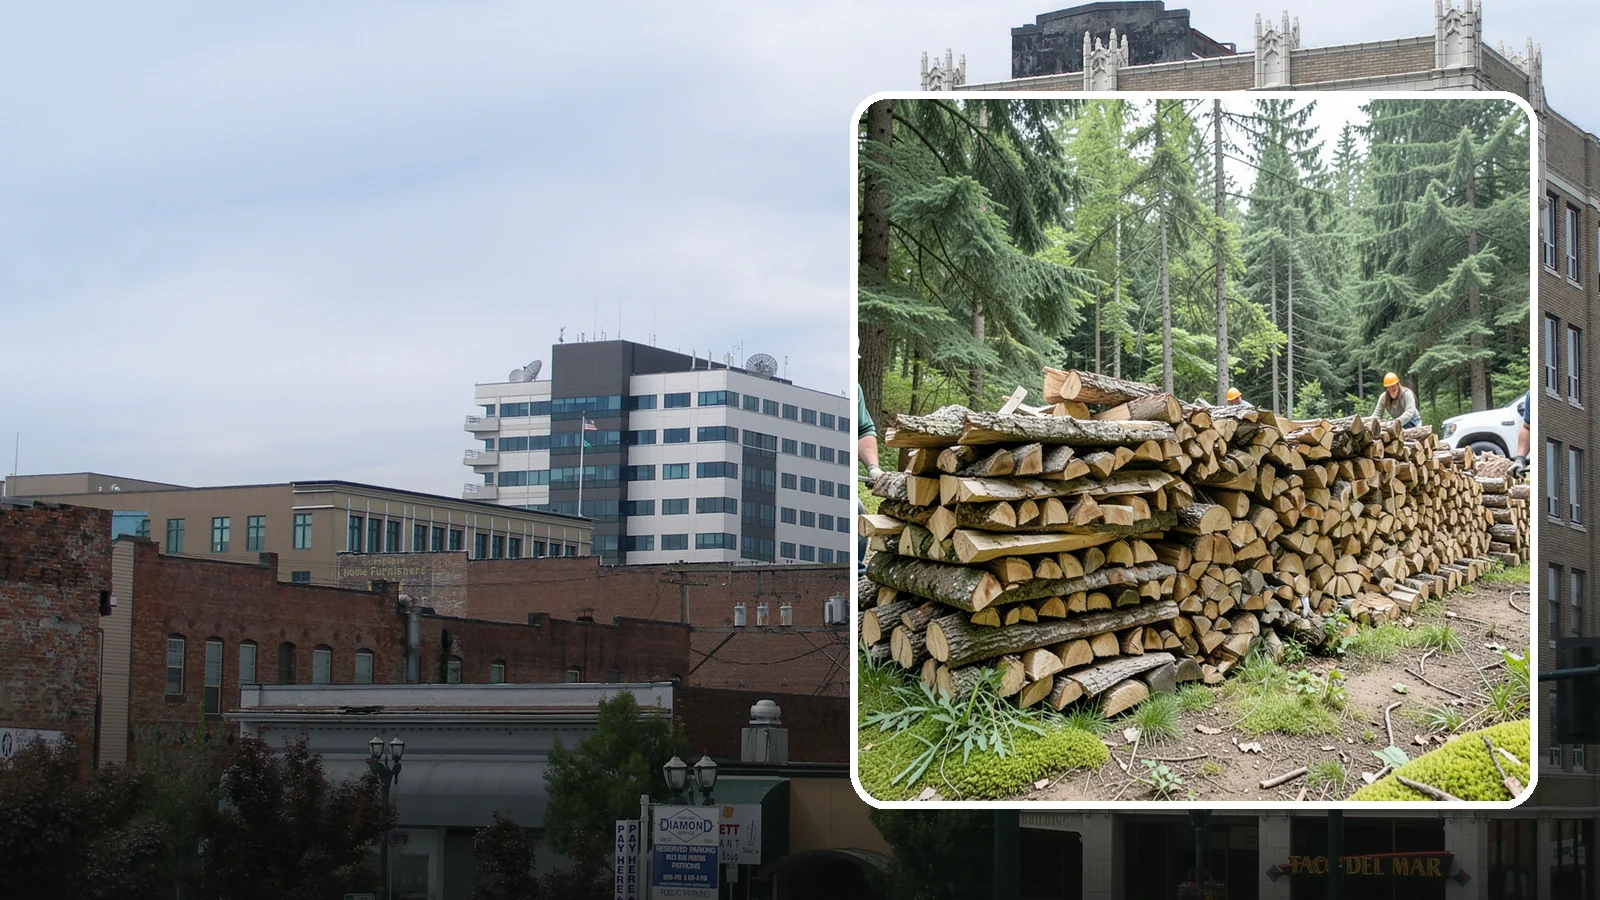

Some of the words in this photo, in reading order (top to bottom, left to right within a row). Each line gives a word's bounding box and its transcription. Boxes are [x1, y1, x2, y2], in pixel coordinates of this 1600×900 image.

[343, 567, 367, 577] Home
[370, 566, 427, 576] Furnishers
[1022, 815, 1070, 828] BUILDING
[617, 825, 625, 852] PAY
[628, 824, 637, 852] PAY
[656, 845, 688, 853] RESERVED
[689, 846, 716, 854] PARKING
[671, 862, 701, 870] PATRONS
[1289, 855, 1329, 874] TAC
[1346, 856, 1385, 875] DEL
[1392, 857, 1442, 877] MAR
[616, 856, 625, 894] HERE
[627, 856, 636, 894] HERE
[660, 889, 682, 897] PUBLIC
[683, 889, 710, 898] PARKING
